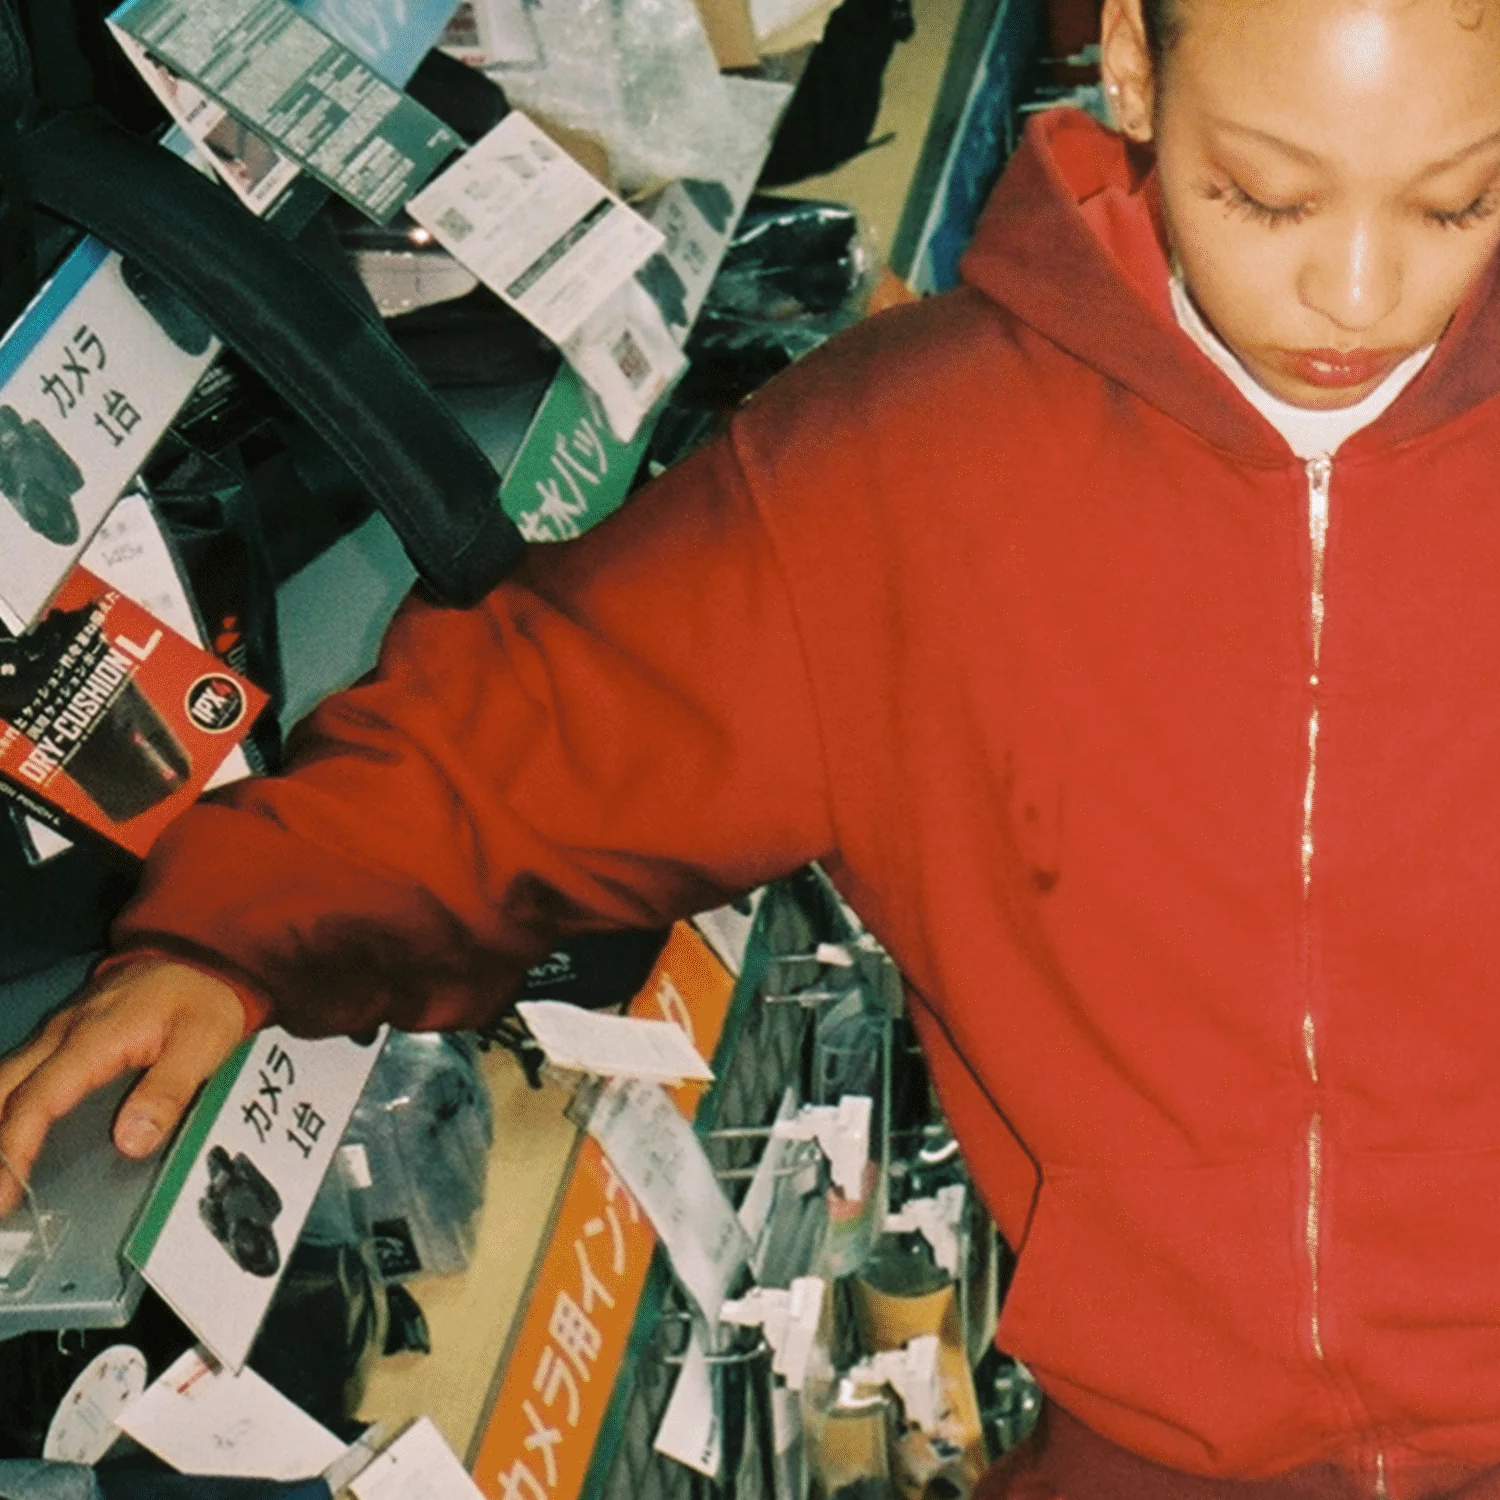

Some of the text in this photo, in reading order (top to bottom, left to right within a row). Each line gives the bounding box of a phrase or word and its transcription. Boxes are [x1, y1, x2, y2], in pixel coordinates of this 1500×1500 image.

[39, 324, 107, 419] カメラ
[93, 389, 141, 448] 1台
[241, 1043, 298, 1143] カメラ
[286, 1101, 327, 1160] 1台
